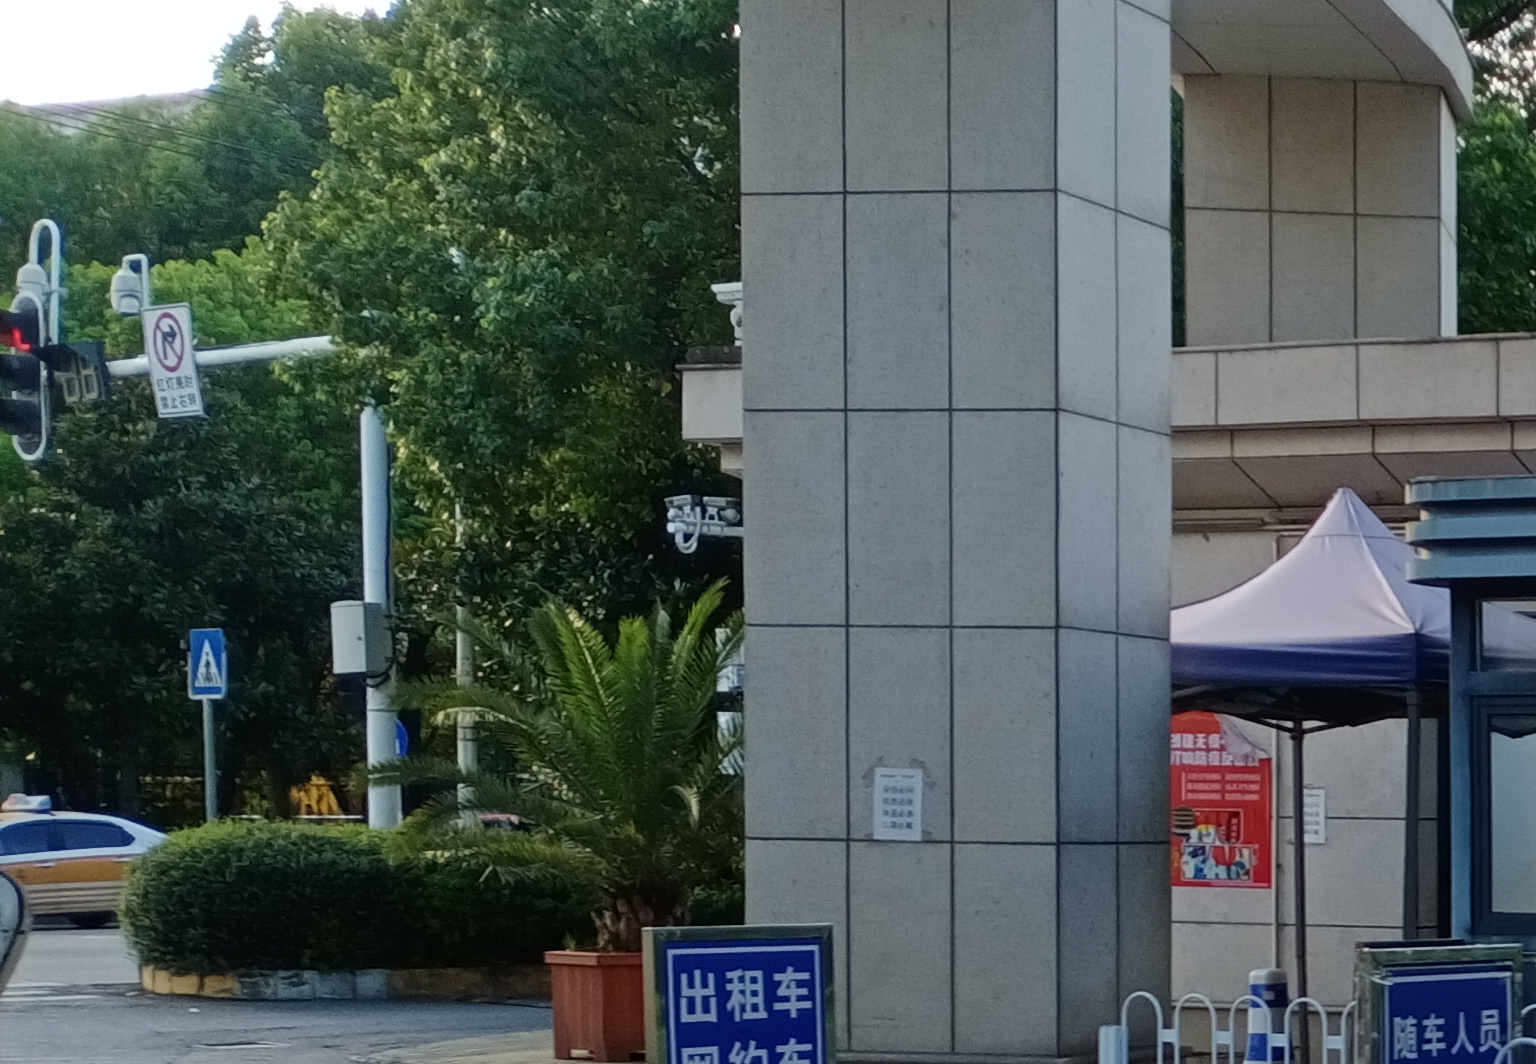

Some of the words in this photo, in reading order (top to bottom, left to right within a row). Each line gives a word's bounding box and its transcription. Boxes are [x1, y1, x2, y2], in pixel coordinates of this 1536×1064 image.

[679, 966, 813, 1023] 出租车
[1393, 1008, 1501, 1060] 随车人员
